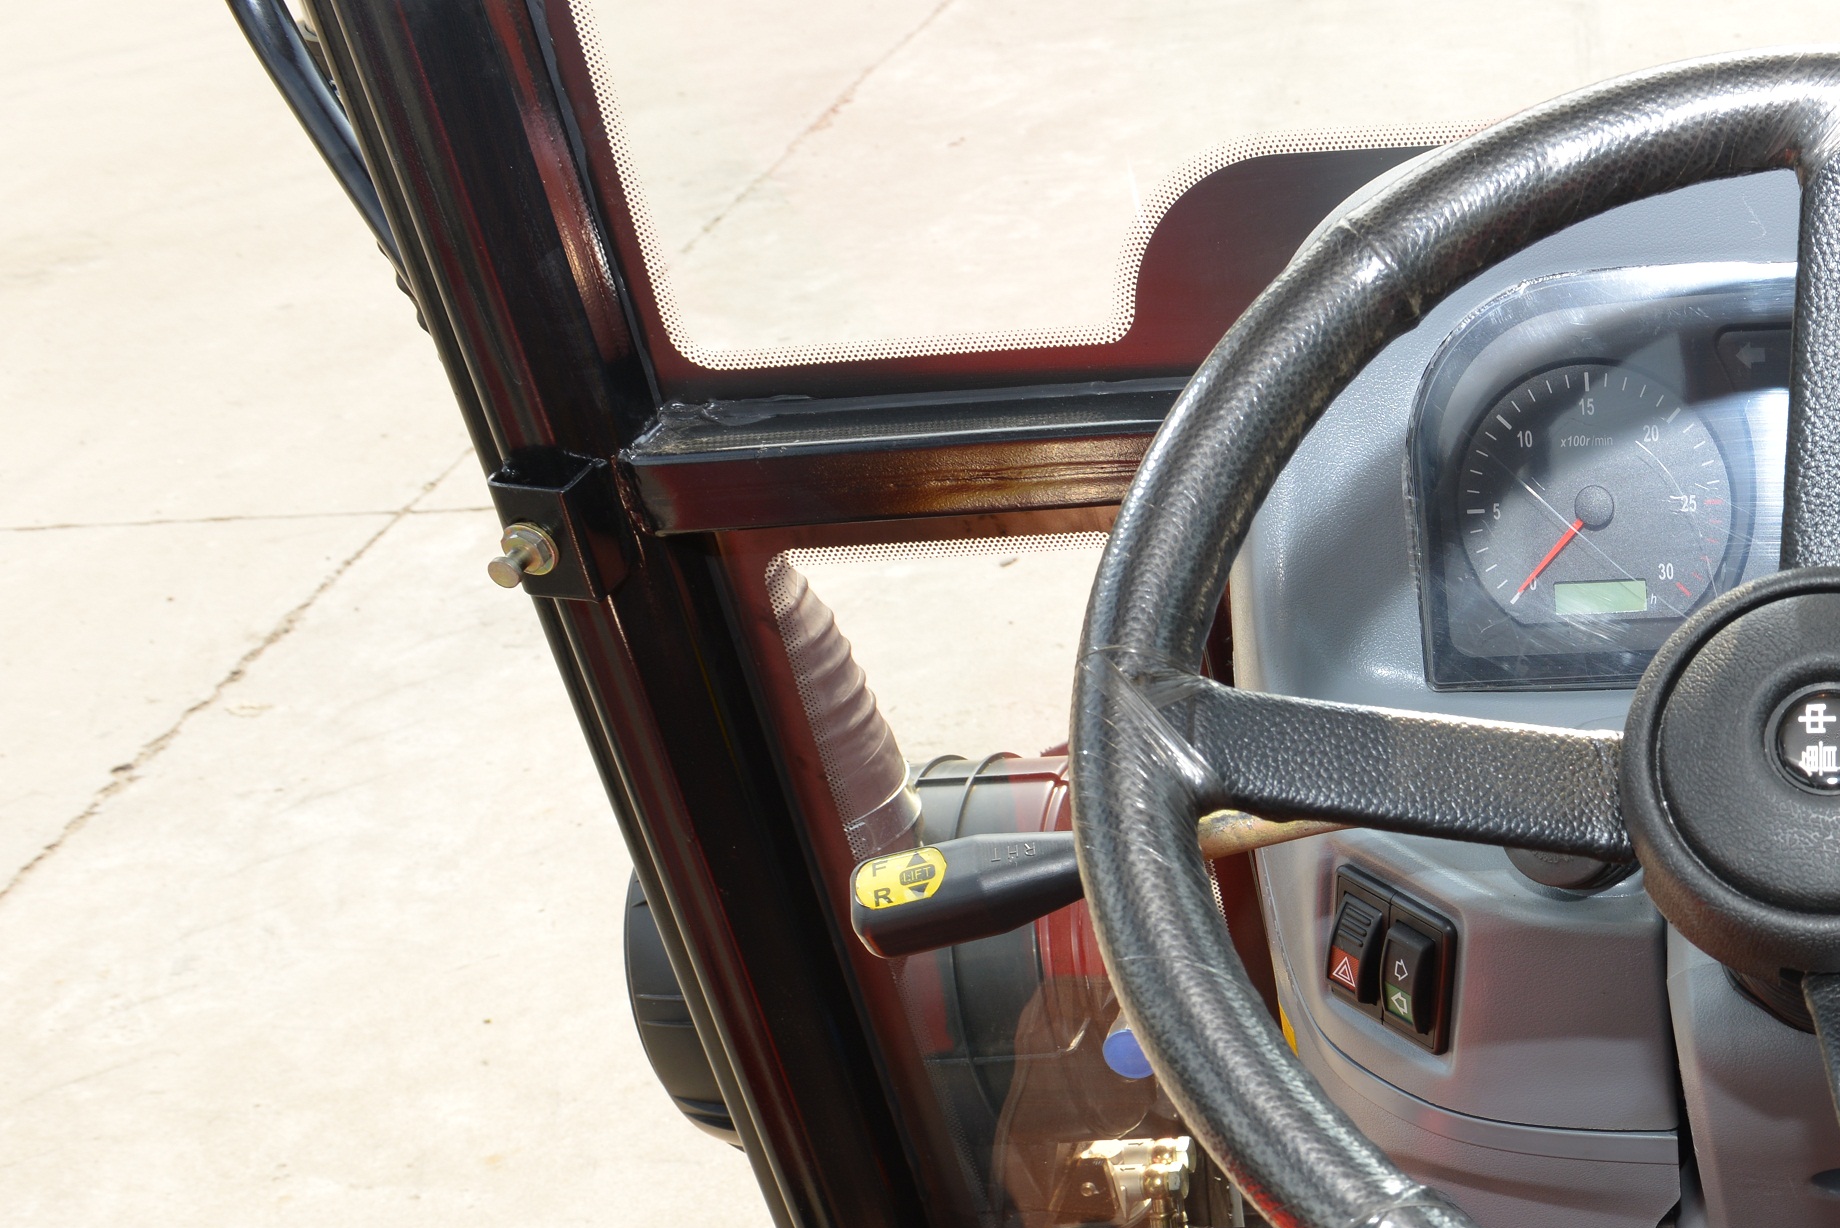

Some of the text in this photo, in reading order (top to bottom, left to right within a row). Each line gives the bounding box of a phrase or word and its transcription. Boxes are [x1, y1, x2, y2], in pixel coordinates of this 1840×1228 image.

[1578, 398, 1595, 416] 15
[1517, 430, 1533, 448] 10
[1643, 425, 1659, 442] 20
[1492, 503, 1501, 520] 5
[1681, 495, 1697, 512] 25
[1658, 563, 1674, 580] 30
[872, 860, 889, 877] F
[902, 866, 931, 883] LIFT
[873, 887, 894, 907] R
